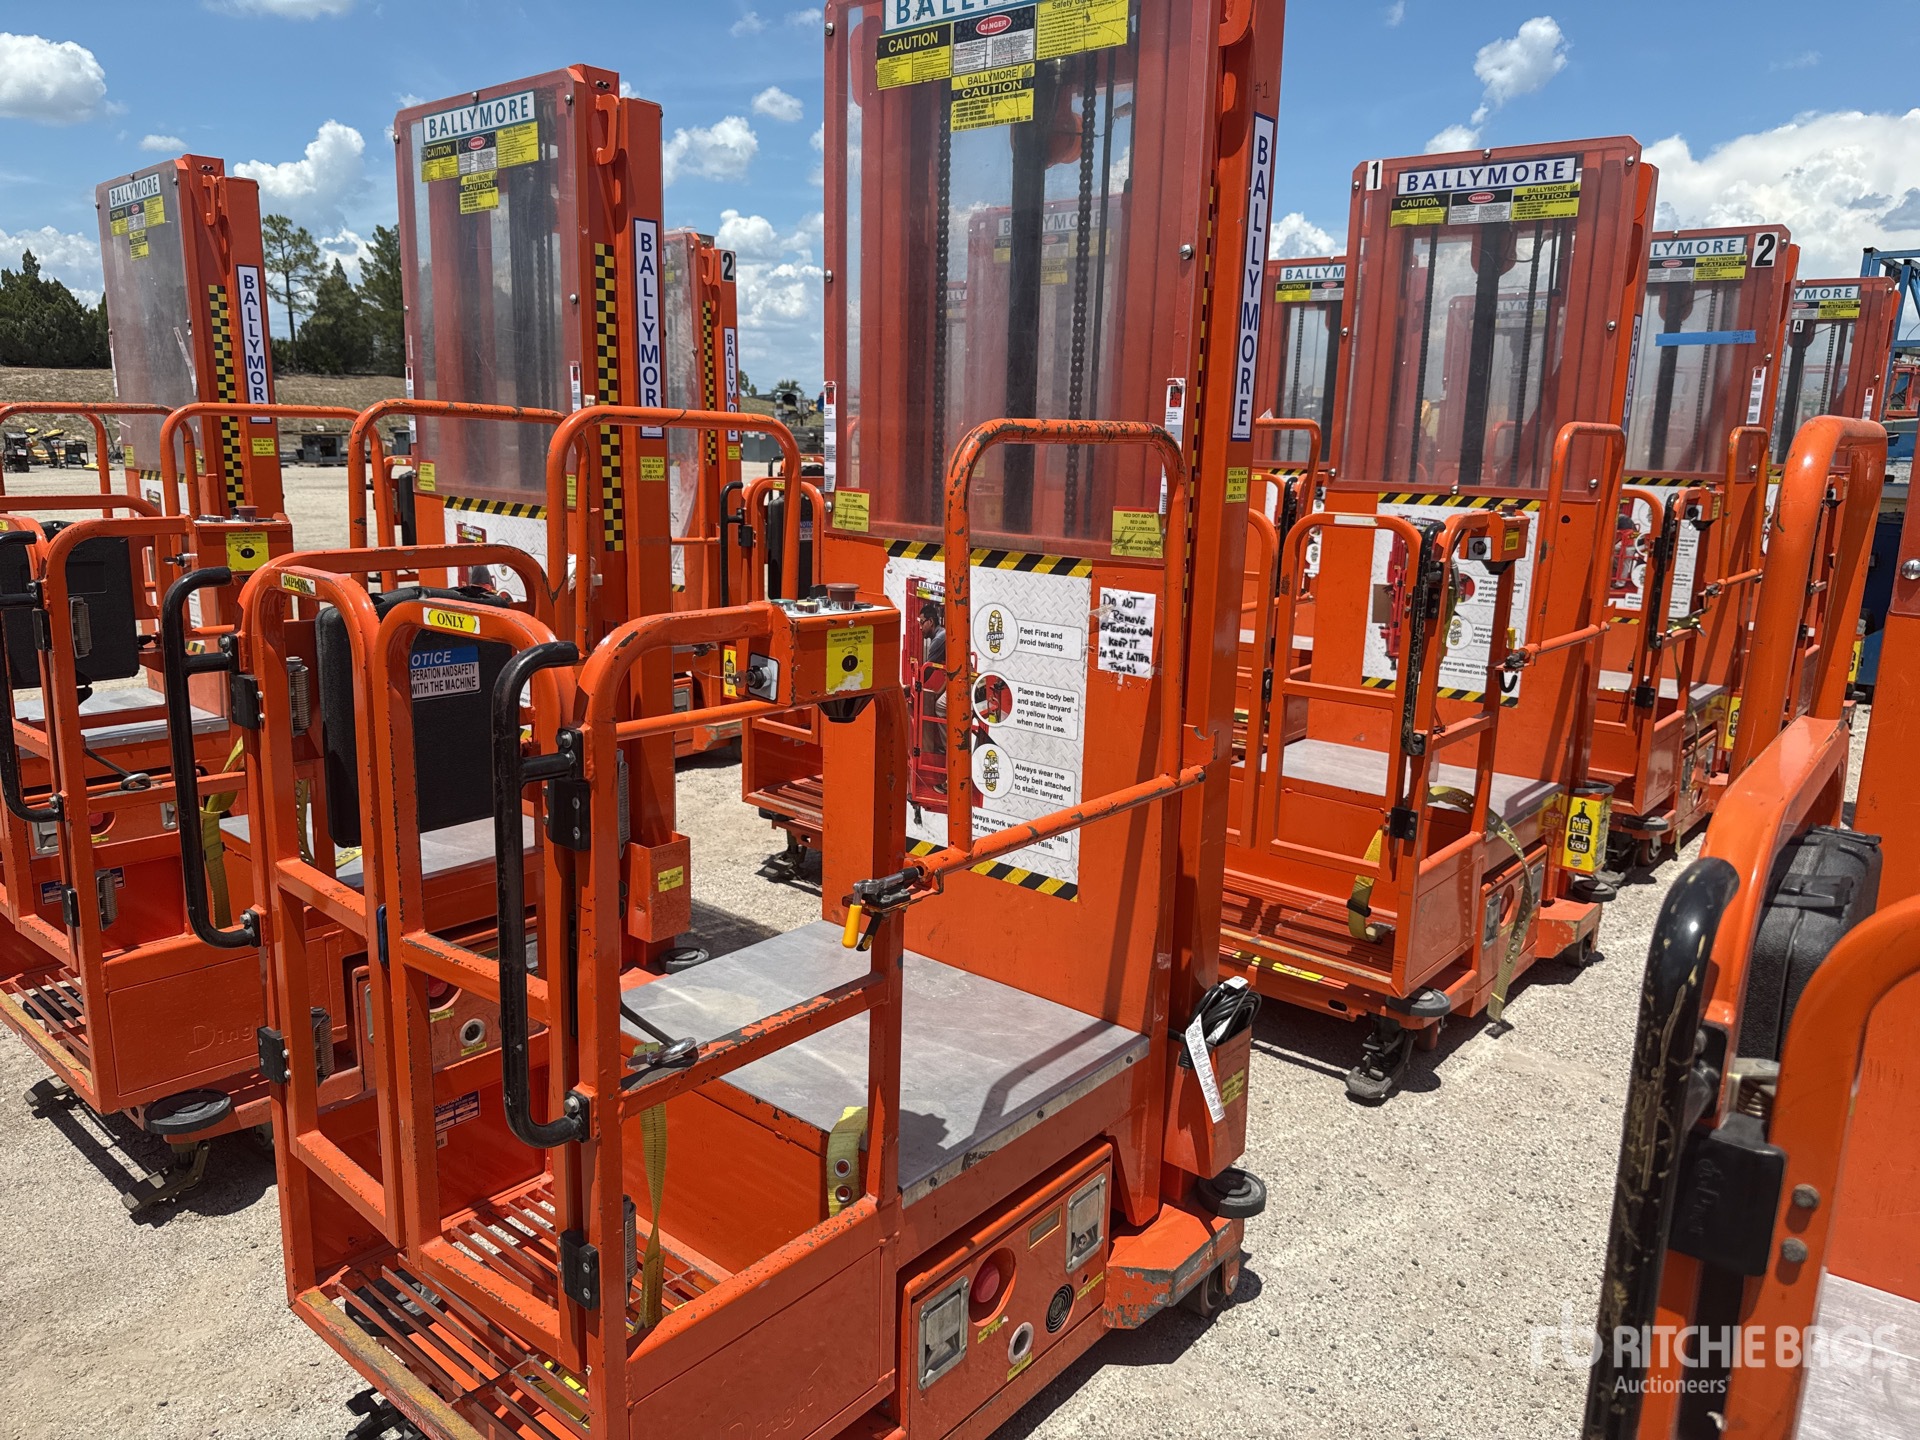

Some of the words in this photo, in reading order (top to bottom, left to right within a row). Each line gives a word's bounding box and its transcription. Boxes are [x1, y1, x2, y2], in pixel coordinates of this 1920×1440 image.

[980, 19, 1008, 31] DANGER
[888, 31, 939, 53] CAUTION
[967, 69, 1018, 85] BALLYMORE
[962, 80, 1022, 98] CAUTION
[429, 96, 529, 139] BALLYMORE
[426, 145, 452, 158] CAUTION
[1371, 162, 1379, 189] 1
[1406, 161, 1566, 191] BALLYMORE
[110, 176, 158, 206] BALLYMORE
[464, 182, 493, 192] CAUTION
[1527, 185, 1567, 193] BALLYMORE
[1401, 197, 1440, 208] CAUTION
[1522, 192, 1571, 201] CAUTION
[1755, 234, 1776, 267] 2
[722, 252, 733, 280] 2
[1239, 135, 1268, 427] BALLYMORE
[639, 232, 659, 428] BALLYMOR
[1794, 321, 1801, 331] A
[243, 275, 265, 404] BALLYMOR
[437, 613, 465, 629] ONLY
[986, 632, 1004, 641] FORM
[1020, 627, 1034, 636] Feet
[1035, 629, 1049, 638] First
[1051, 631, 1063, 639] and
[1020, 638, 1036, 646] avoid
[1038, 640, 1065, 652] twisting.
[411, 651, 452, 667] OTICE
[412, 667, 441, 681] PERATION
[411, 682, 429, 695] WITH
[430, 680, 444, 692] THE
[445, 676, 476, 690] MACHINE
[1017, 687, 1035, 697] Place
[1035, 689, 1045, 698] the
[1046, 691, 1061, 703] body
[1062, 694, 1075, 704] belt
[1017, 698, 1029, 706] and
[1030, 699, 1046, 709] static
[1047, 703, 1071, 714] lanyard
[1026, 709, 1046, 719] yellow
[1047, 713, 1063, 722] hook
[1016, 718, 1033, 728] when
[1034, 721, 1044, 729] not
[1053, 726, 1066, 734] use.
[983, 772, 999, 780] GEAR
[1015, 763, 1037, 775] Always
[1038, 769, 1053, 778] wear
[1054, 772, 1065, 781] the
[1014, 773, 1030, 784] body
[1031, 776, 1043, 785] belt
[1044, 780, 1072, 793] attached
[1022, 785, 1039, 796] static
[1039, 789, 1065, 801] lanyard.
[972, 813, 990, 824] lways
[991, 817, 1006, 828] work
[1571, 822, 1590, 831] ME
[980, 825, 997, 834] never
[1038, 841, 1055, 850] rails.
[1054, 835, 1069, 844] rails
[1570, 841, 1588, 850] YOU
[188, 1024, 255, 1054] Ding
